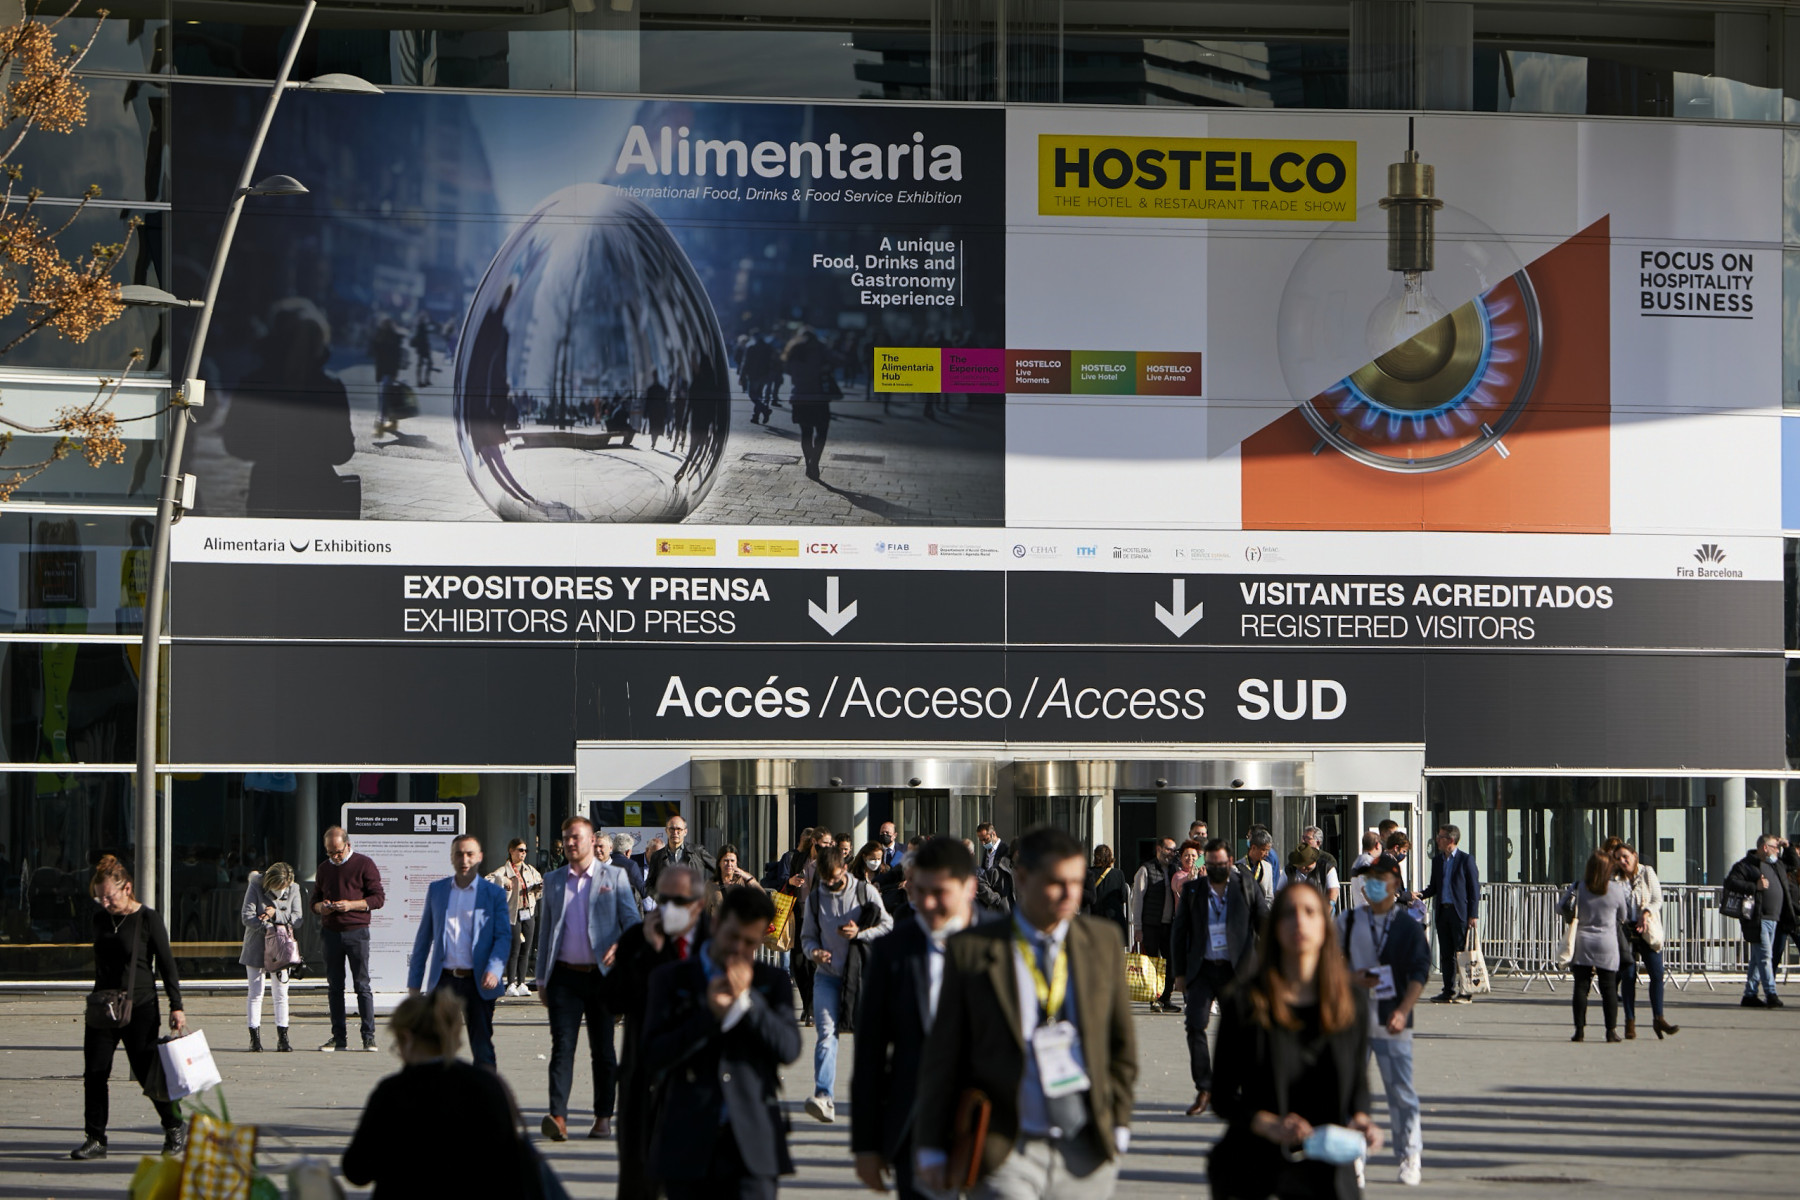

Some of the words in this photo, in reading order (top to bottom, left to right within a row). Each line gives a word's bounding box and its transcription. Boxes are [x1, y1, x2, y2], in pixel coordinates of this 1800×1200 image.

[615, 125, 963, 182] Alimentaria
[1054, 147, 1347, 194] HOSTELCO
[615, 185, 699, 200] International
[703, 186, 741, 203] Food,
[746, 187, 788, 202] Drinks
[792, 188, 802, 202] &
[805, 188, 841, 202] Food
[844, 189, 893, 203] Service
[897, 190, 962, 205] Exhibition
[1054, 195, 1081, 208] THE
[1087, 196, 1132, 209] HOTEL
[1139, 197, 1148, 209] &
[1154, 197, 1245, 211] RESTAURANT
[1252, 199, 1298, 212] TRADE
[1304, 200, 1347, 212] SHOW
[879, 237, 892, 251] A
[897, 238, 956, 255] unique
[812, 254, 859, 271] Food,
[865, 254, 919, 270] Drinks
[924, 255, 956, 270] and
[1640, 251, 1714, 271] FOCUS
[1721, 253, 1753, 272] ON
[851, 272, 956, 292] Gastronomy
[1640, 272, 1754, 290] HOSPITALITY
[860, 290, 956, 308] Experience
[1640, 291, 1754, 312] BUSINESS
[881, 353, 899, 362] The
[949, 355, 967, 363] The
[1015, 360, 1062, 368] HOSTELCO
[881, 363, 934, 372] Alimentaria
[949, 364, 999, 374] Experience
[1081, 364, 1127, 372] HOSTELCO
[1146, 365, 1192, 373] HOSTELCO
[881, 372, 901, 381] Hub
[1015, 376, 1050, 384] Moments
[1098, 373, 1118, 381] Hotel
[1164, 374, 1186, 382] Arena
[203, 537, 285, 551] Alimentaria
[314, 539, 392, 553] Exhibitions
[887, 543, 910, 551] FIAB
[1030, 546, 1058, 554] CEHAT
[1076, 547, 1096, 556] ITH
[1676, 566, 1695, 577] Fira
[1697, 567, 1743, 578] Barcelona
[403, 575, 614, 600] EXPOSITORES
[620, 576, 642, 600] Y
[650, 577, 771, 602] PRENSA
[1239, 582, 1405, 607] VISITANTES
[1412, 583, 1614, 609] ACREDITADOS
[403, 608, 568, 633] EXHIBITORS
[575, 609, 636, 634] AND
[645, 610, 737, 634] PRESS
[1240, 614, 1408, 639] REGISTERED
[1415, 615, 1536, 640] VISITORS
[655, 675, 811, 718] Accés
[1236, 678, 1347, 721] SUD
[418, 816, 427, 825] A
[441, 816, 450, 825] H
